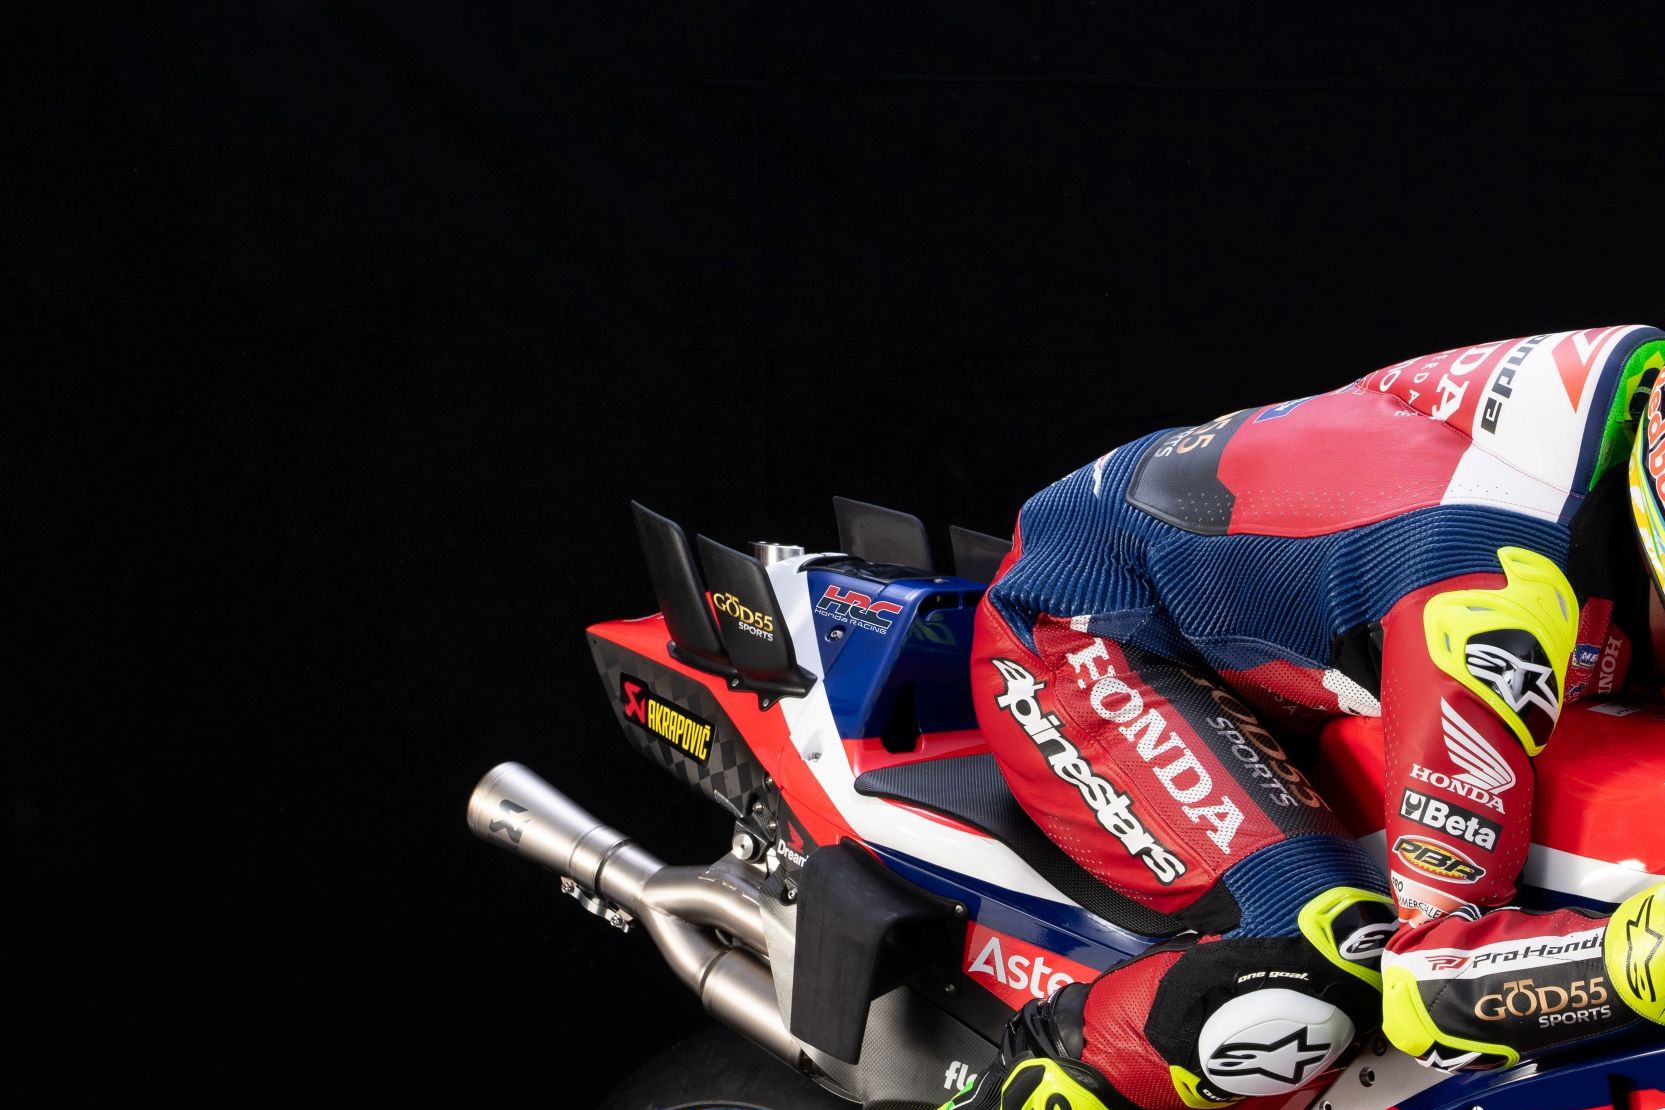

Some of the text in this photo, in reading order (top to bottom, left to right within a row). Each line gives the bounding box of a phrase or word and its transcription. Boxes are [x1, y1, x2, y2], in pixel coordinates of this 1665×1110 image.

[814, 607, 887, 635] Honda RACING
[815, 584, 904, 630] HRC
[738, 621, 774, 642] SPORTS
[1067, 637, 1246, 856] HONDA
[1205, 716, 1299, 807] SPORTS
[991, 657, 1188, 886] alpinestars
[1408, 763, 1506, 814] HONDA
[1422, 798, 1497, 851] Beta
[1393, 836, 1486, 880] PBR
[1237, 971, 1266, 983] one
[1538, 1004, 1612, 1029] SPORTS
